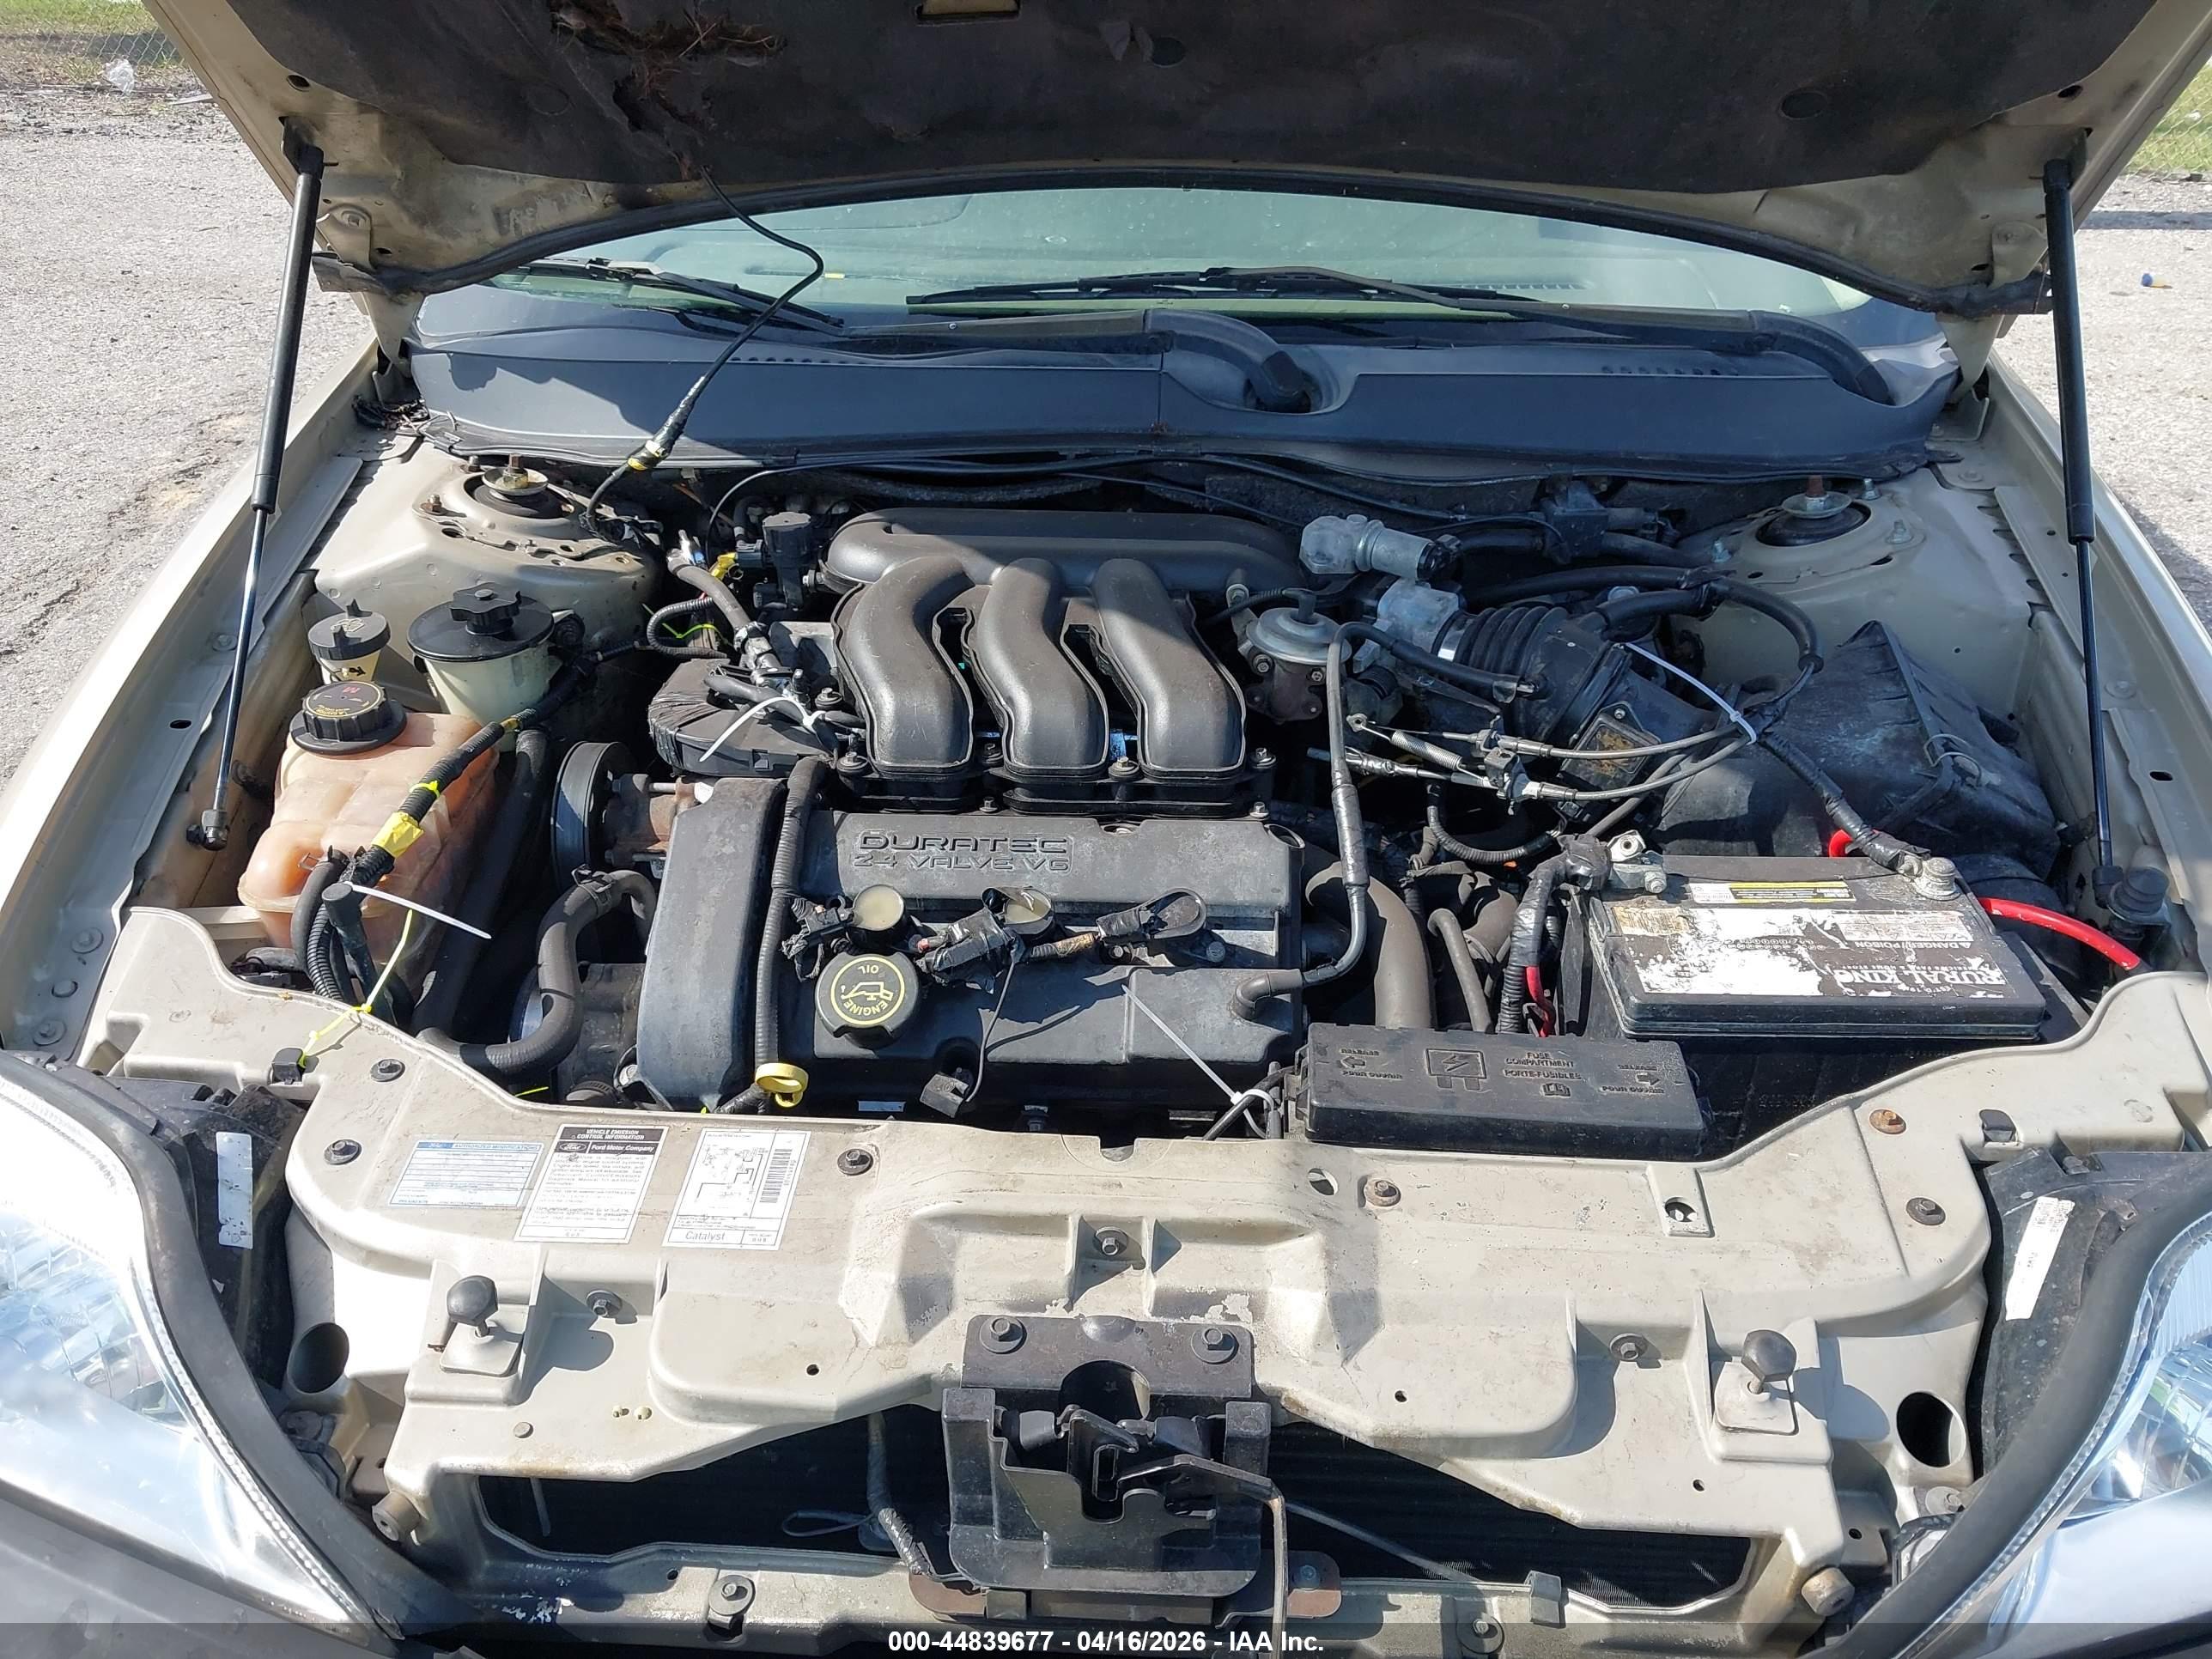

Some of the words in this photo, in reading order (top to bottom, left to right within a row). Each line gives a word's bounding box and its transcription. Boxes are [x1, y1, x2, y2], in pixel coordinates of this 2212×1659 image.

[860, 834, 1071, 854] DURATEC
[854, 854, 898, 869] 24
[908, 854, 1017, 871] VALVE
[1024, 856, 1073, 872] V6
[857, 964, 879, 975] OIL
[1833, 969, 1900, 984] KING
[1903, 970, 2002, 985] RURAL
[842, 998, 888, 1017] ENGINE
[1506, 1058, 1575, 1068] COMPARTMENT
[1504, 1069, 1583, 1080] PORTE-FUSIBLES
[685, 1230, 726, 1242] Catalyst
